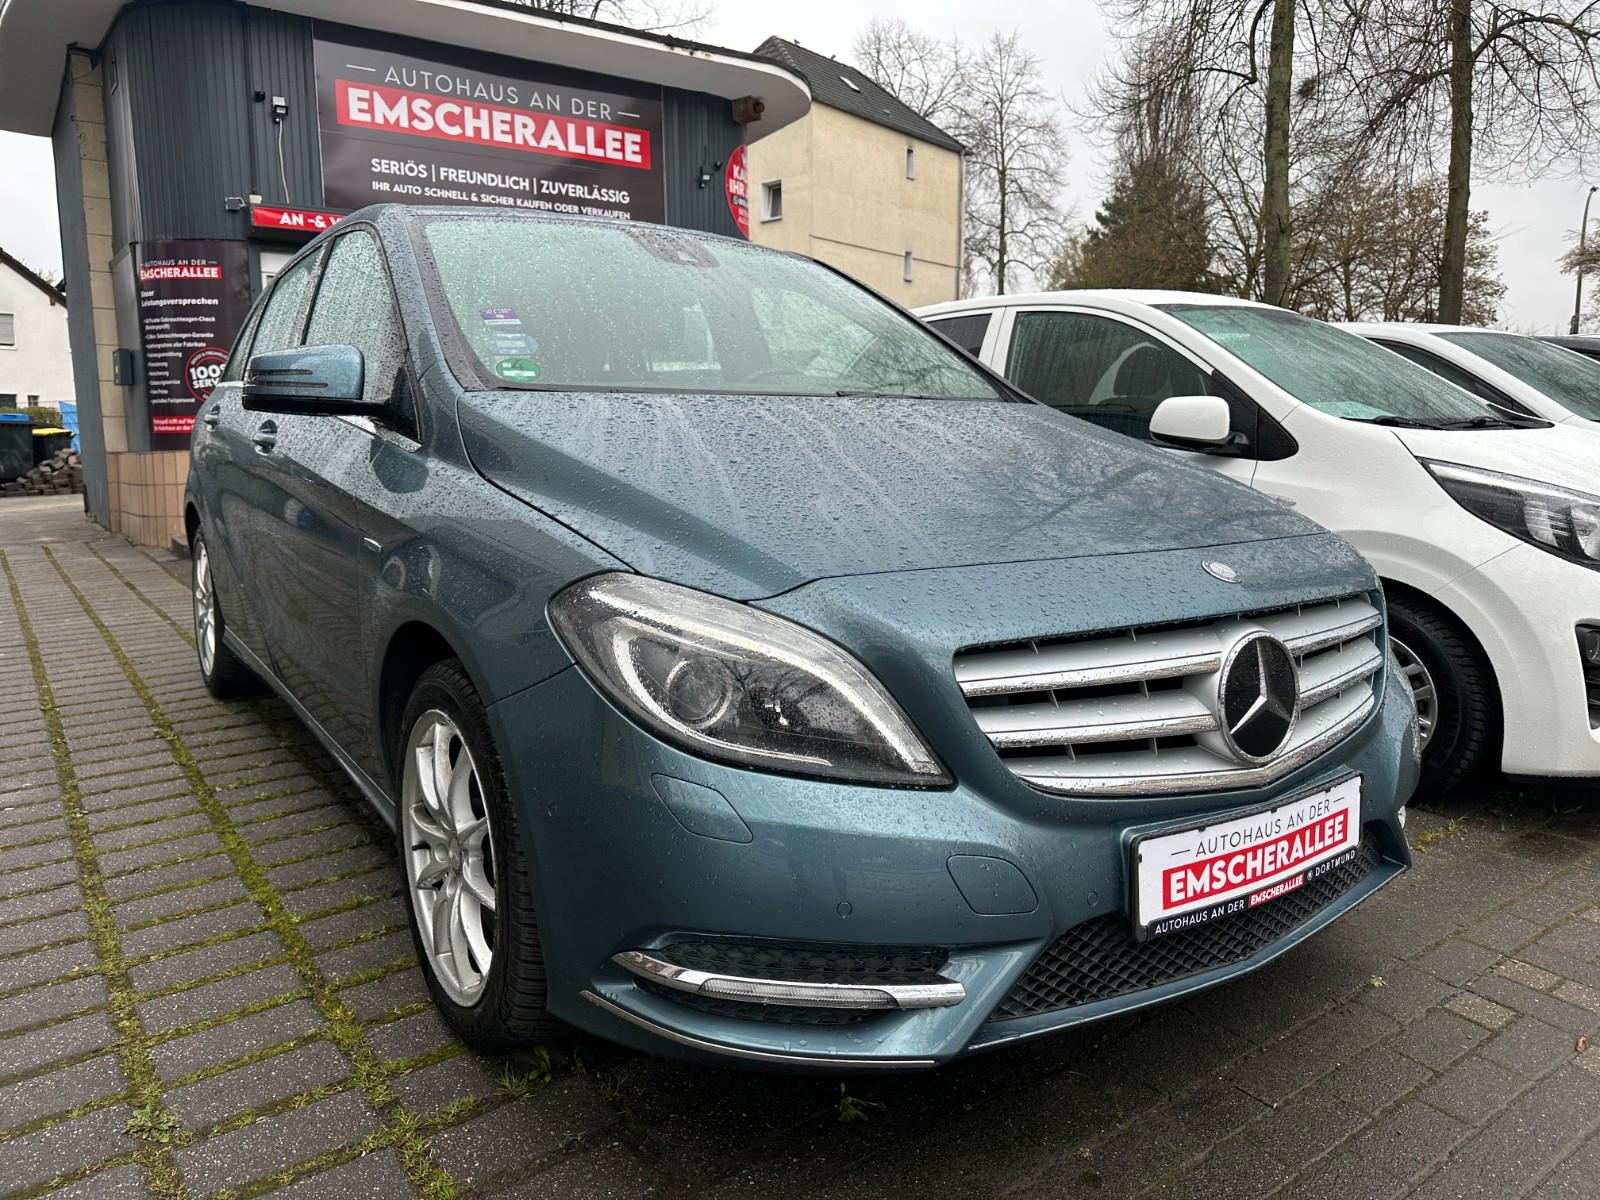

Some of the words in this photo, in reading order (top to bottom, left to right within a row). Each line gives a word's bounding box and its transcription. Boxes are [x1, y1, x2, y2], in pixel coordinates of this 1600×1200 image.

[384, 66, 519, 105] AUTOHAUS
[530, 92, 560, 111] AN
[571, 98, 612, 121] DER
[347, 87, 642, 164] EMSCHERALLEE
[371, 158, 428, 178] SERIÖS
[440, 169, 529, 191] FREUNDLICH
[540, 177, 630, 204] ZUVERLÄSSIG
[372, 181, 390, 192] IHR
[393, 183, 422, 196] AUTO
[424, 187, 469, 201] SCHNELL
[471, 192, 478, 202] &
[480, 193, 514, 206] SICHER
[516, 198, 552, 210] KAUFEN
[554, 202, 579, 214] ODER
[580, 206, 631, 220] VERKAUFEN
[279, 212, 304, 226] AN
[140, 267, 218, 280] EMSCHERALLEE
[193, 378, 219, 389] SERV
[1195, 818, 1281, 857] AUTOHAUS
[1287, 810, 1304, 829] AN
[1309, 799, 1330, 820] DER
[1170, 814, 1345, 903] EMSCHERALLEE
[1155, 912, 1208, 935] AUTOHAUS
[1211, 906, 1225, 919] AN
[1227, 899, 1244, 914] DER
[1250, 875, 1304, 907] EMSCHERALLEE
[1315, 850, 1356, 877] DORTMUND
